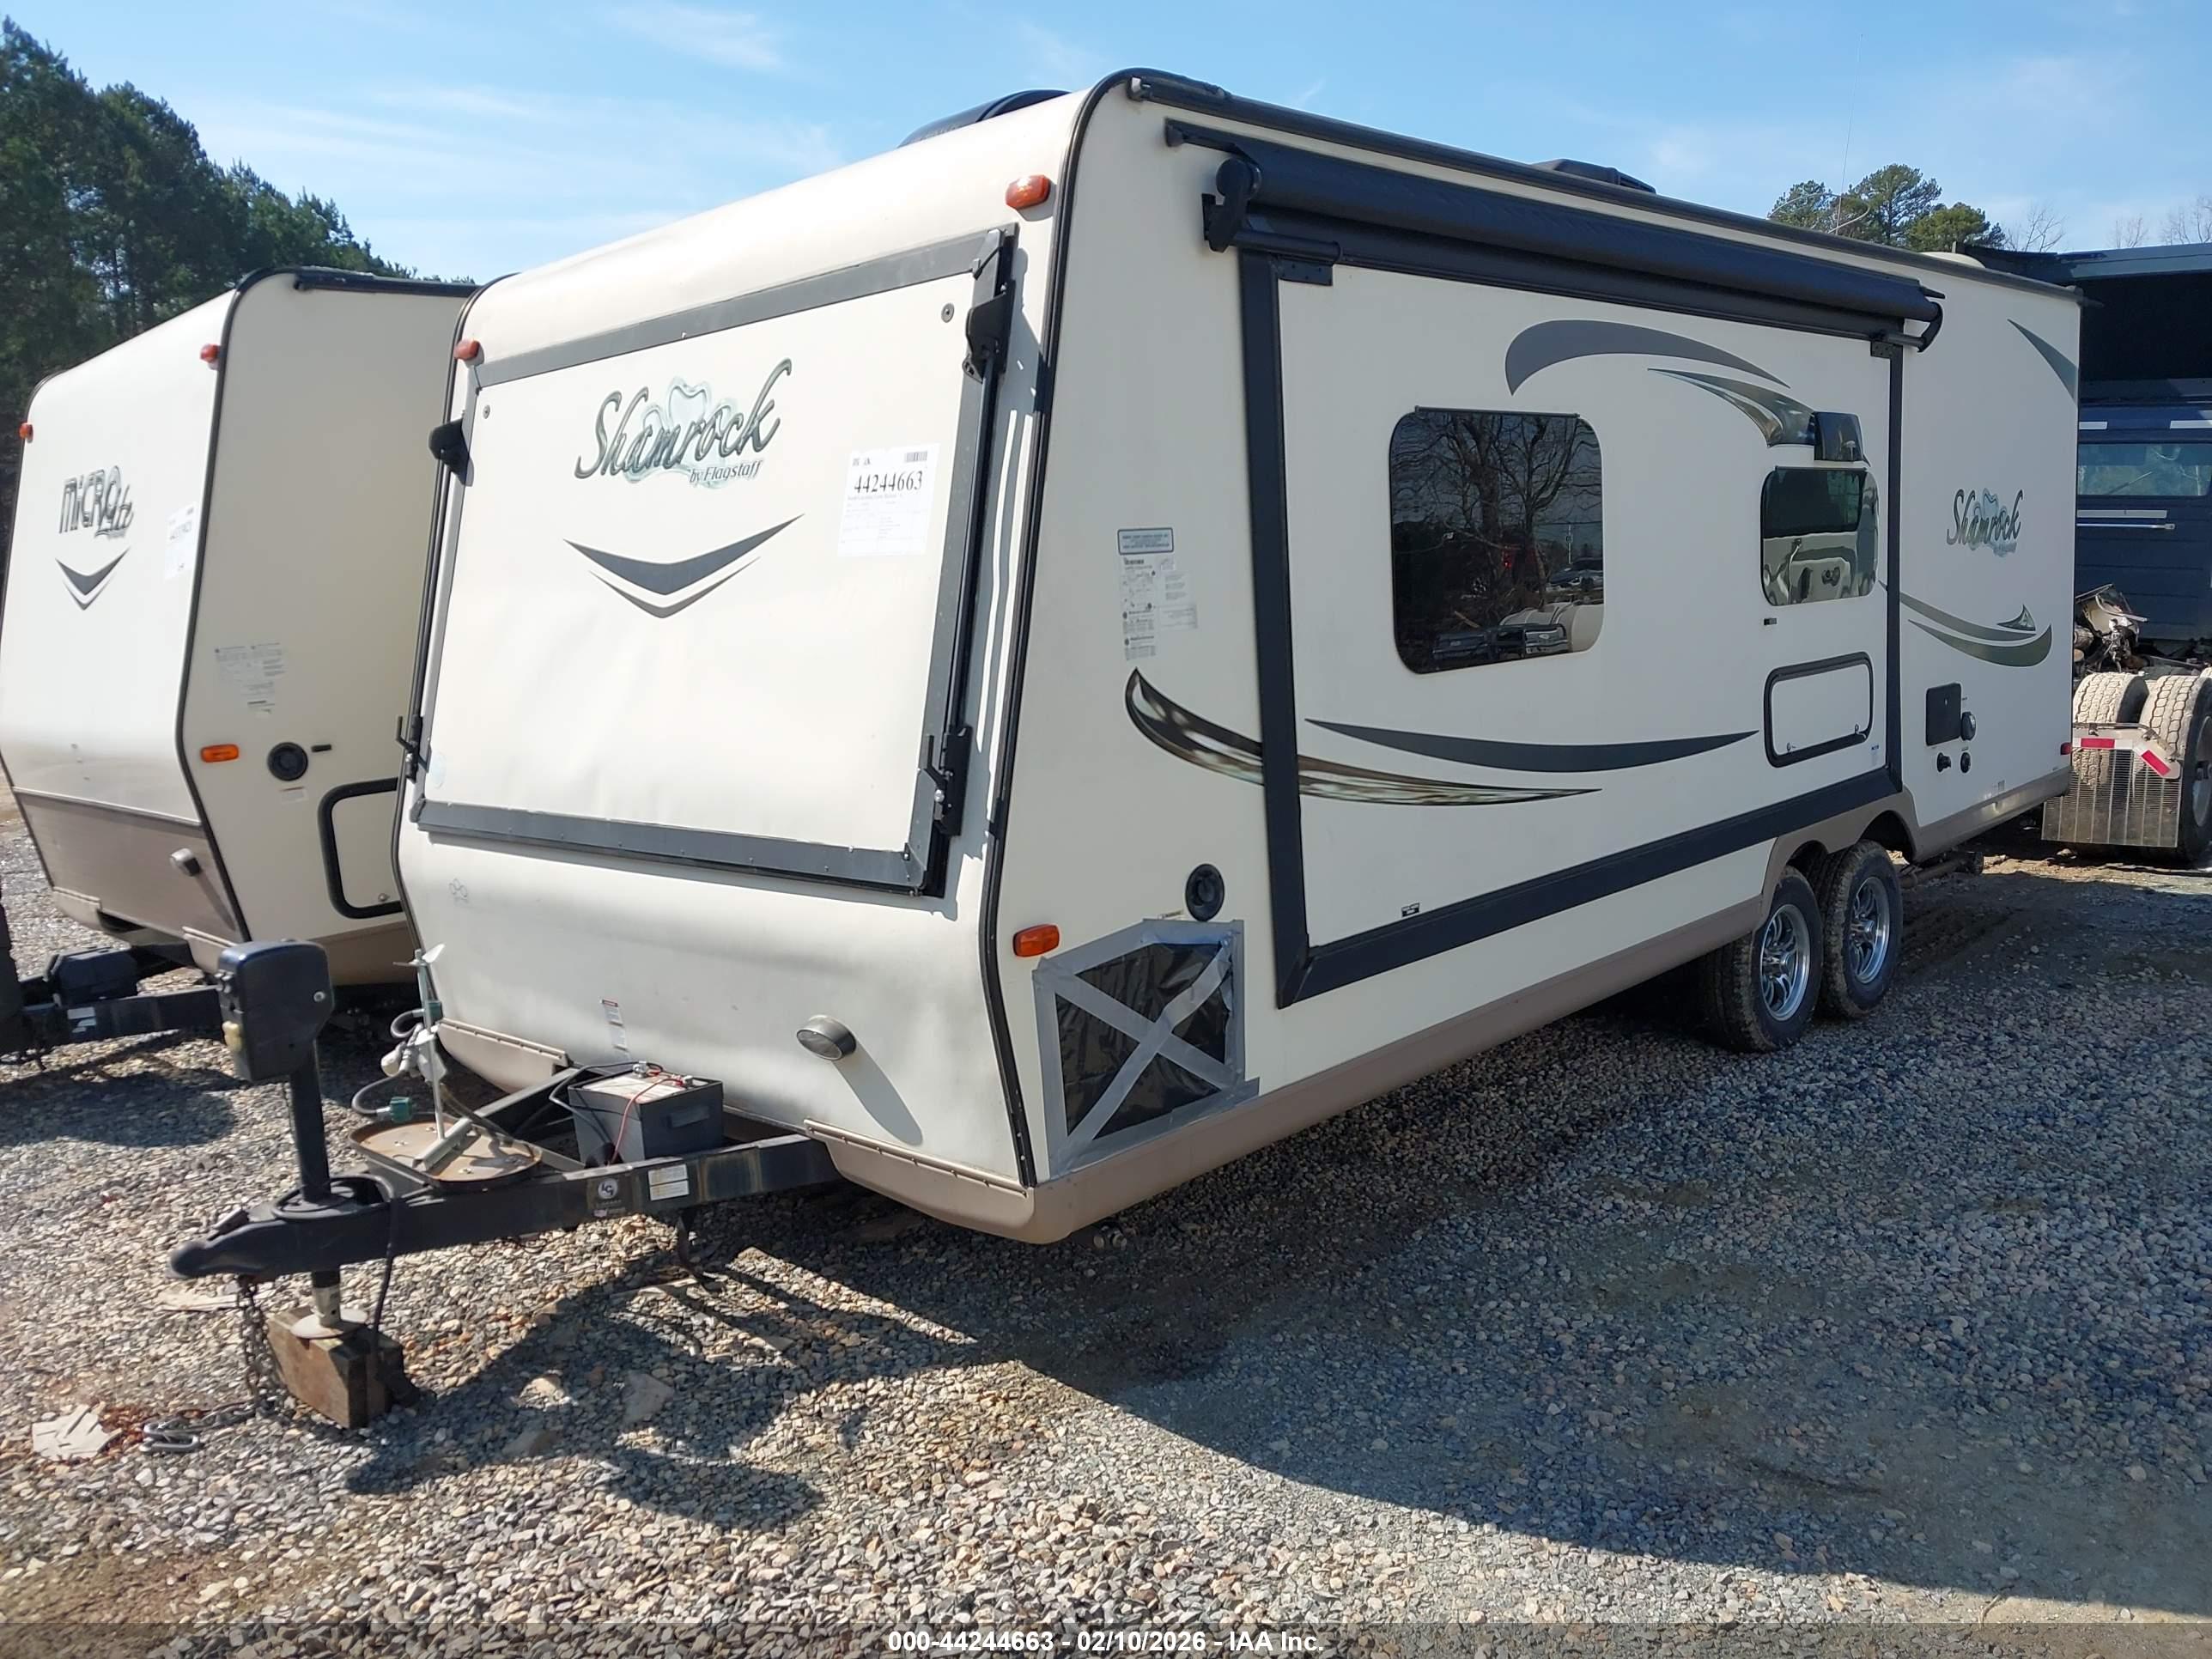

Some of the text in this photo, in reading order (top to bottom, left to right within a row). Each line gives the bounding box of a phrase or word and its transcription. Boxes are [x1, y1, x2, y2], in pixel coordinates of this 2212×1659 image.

[574, 356, 793, 480] Shamrock
[689, 459, 764, 483] by Flagstaff
[854, 470, 923, 494] 44244663
[1946, 489, 2025, 546] Shamrock
